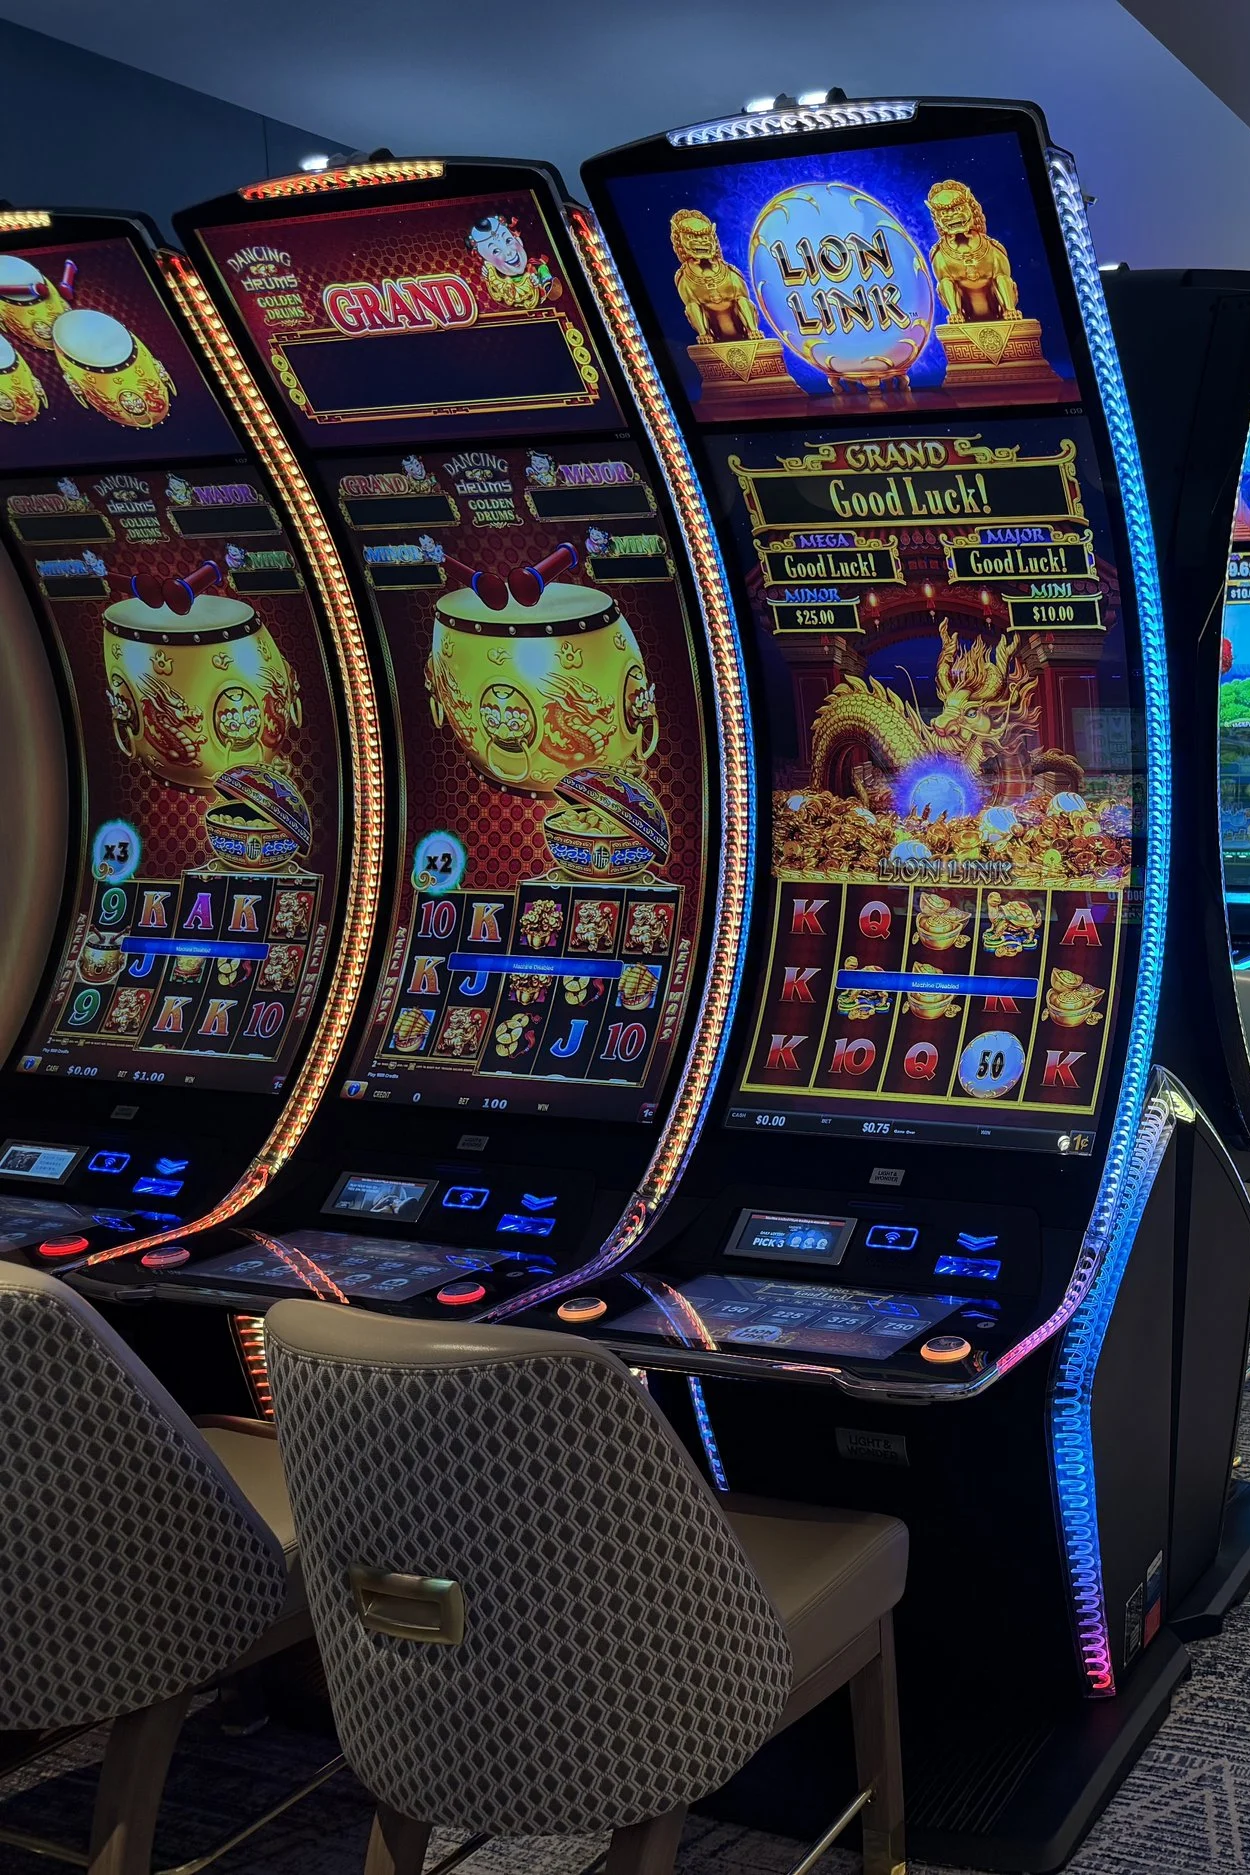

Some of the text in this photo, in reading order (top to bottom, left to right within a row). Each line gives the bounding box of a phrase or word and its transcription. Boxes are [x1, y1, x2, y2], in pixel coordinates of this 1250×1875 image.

[227, 245, 291, 273] DANCING
[771, 229, 895, 287] LION
[257, 293, 301, 309] GOLDEN
[326, 277, 474, 334] GRAND
[786, 283, 912, 336] LINK
[266, 307, 305, 320] DRUMS
[443, 451, 509, 476] DANCING
[844, 440, 948, 470] GRAND
[560, 462, 629, 485] MAJOR
[93, 475, 149, 495] DANCING
[194, 484, 254, 506] MAJOR
[343, 474, 408, 495] GRAND
[9, 497, 68, 514] GRAND
[468, 497, 515, 511] GOLDEN
[829, 473, 991, 519] Good Luck!
[119, 516, 160, 529] GOLDEN
[475, 509, 515, 522] DRUMS
[127, 527, 162, 539] DRUMS
[799, 533, 851, 548] MEGA
[986, 527, 1046, 547] MAJOR
[365, 545, 422, 563] MINOR
[612, 535, 661, 556] MINI
[784, 551, 878, 578] Good Luck!
[970, 547, 1067, 575] Good Luck!
[784, 588, 841, 603] MINOR
[1030, 582, 1073, 598] MINI
[796, 608, 835, 626] $25.00
[1033, 605, 1075, 622] $10.00
[104, 841, 130, 864] x3
[426, 852, 453, 875] x2
[877, 857, 1012, 885] LION LINK
[99, 888, 262, 932] 9 K A K
[417, 900, 504, 942] 10 K
[788, 898, 1103, 947] K Q A
[407, 955, 446, 994] K
[779, 966, 821, 1003] K
[67, 988, 285, 1039] 9 K K 10
[550, 1019, 647, 1061] J 10
[763, 1034, 1087, 1088] K 10 Q 50 K
[45, 1064, 59, 1072] CASH
[66, 1065, 98, 1077] $0.00
[133, 1071, 165, 1083] $1.00
[372, 1089, 549, 1112] CREDIT 0 BET 100 WIN
[755, 1114, 786, 1127] $0.00
[862, 1122, 891, 1135] $0.75
[752, 1237, 785, 1248] PICK 3
[720, 1304, 749, 1315] 150
[775, 1310, 805, 1320] 225
[826, 1316, 857, 1326] 375
[884, 1322, 914, 1332] 750
[846, 1445, 898, 1459] WONDER
[849, 1435, 882, 1448] LIGHT
